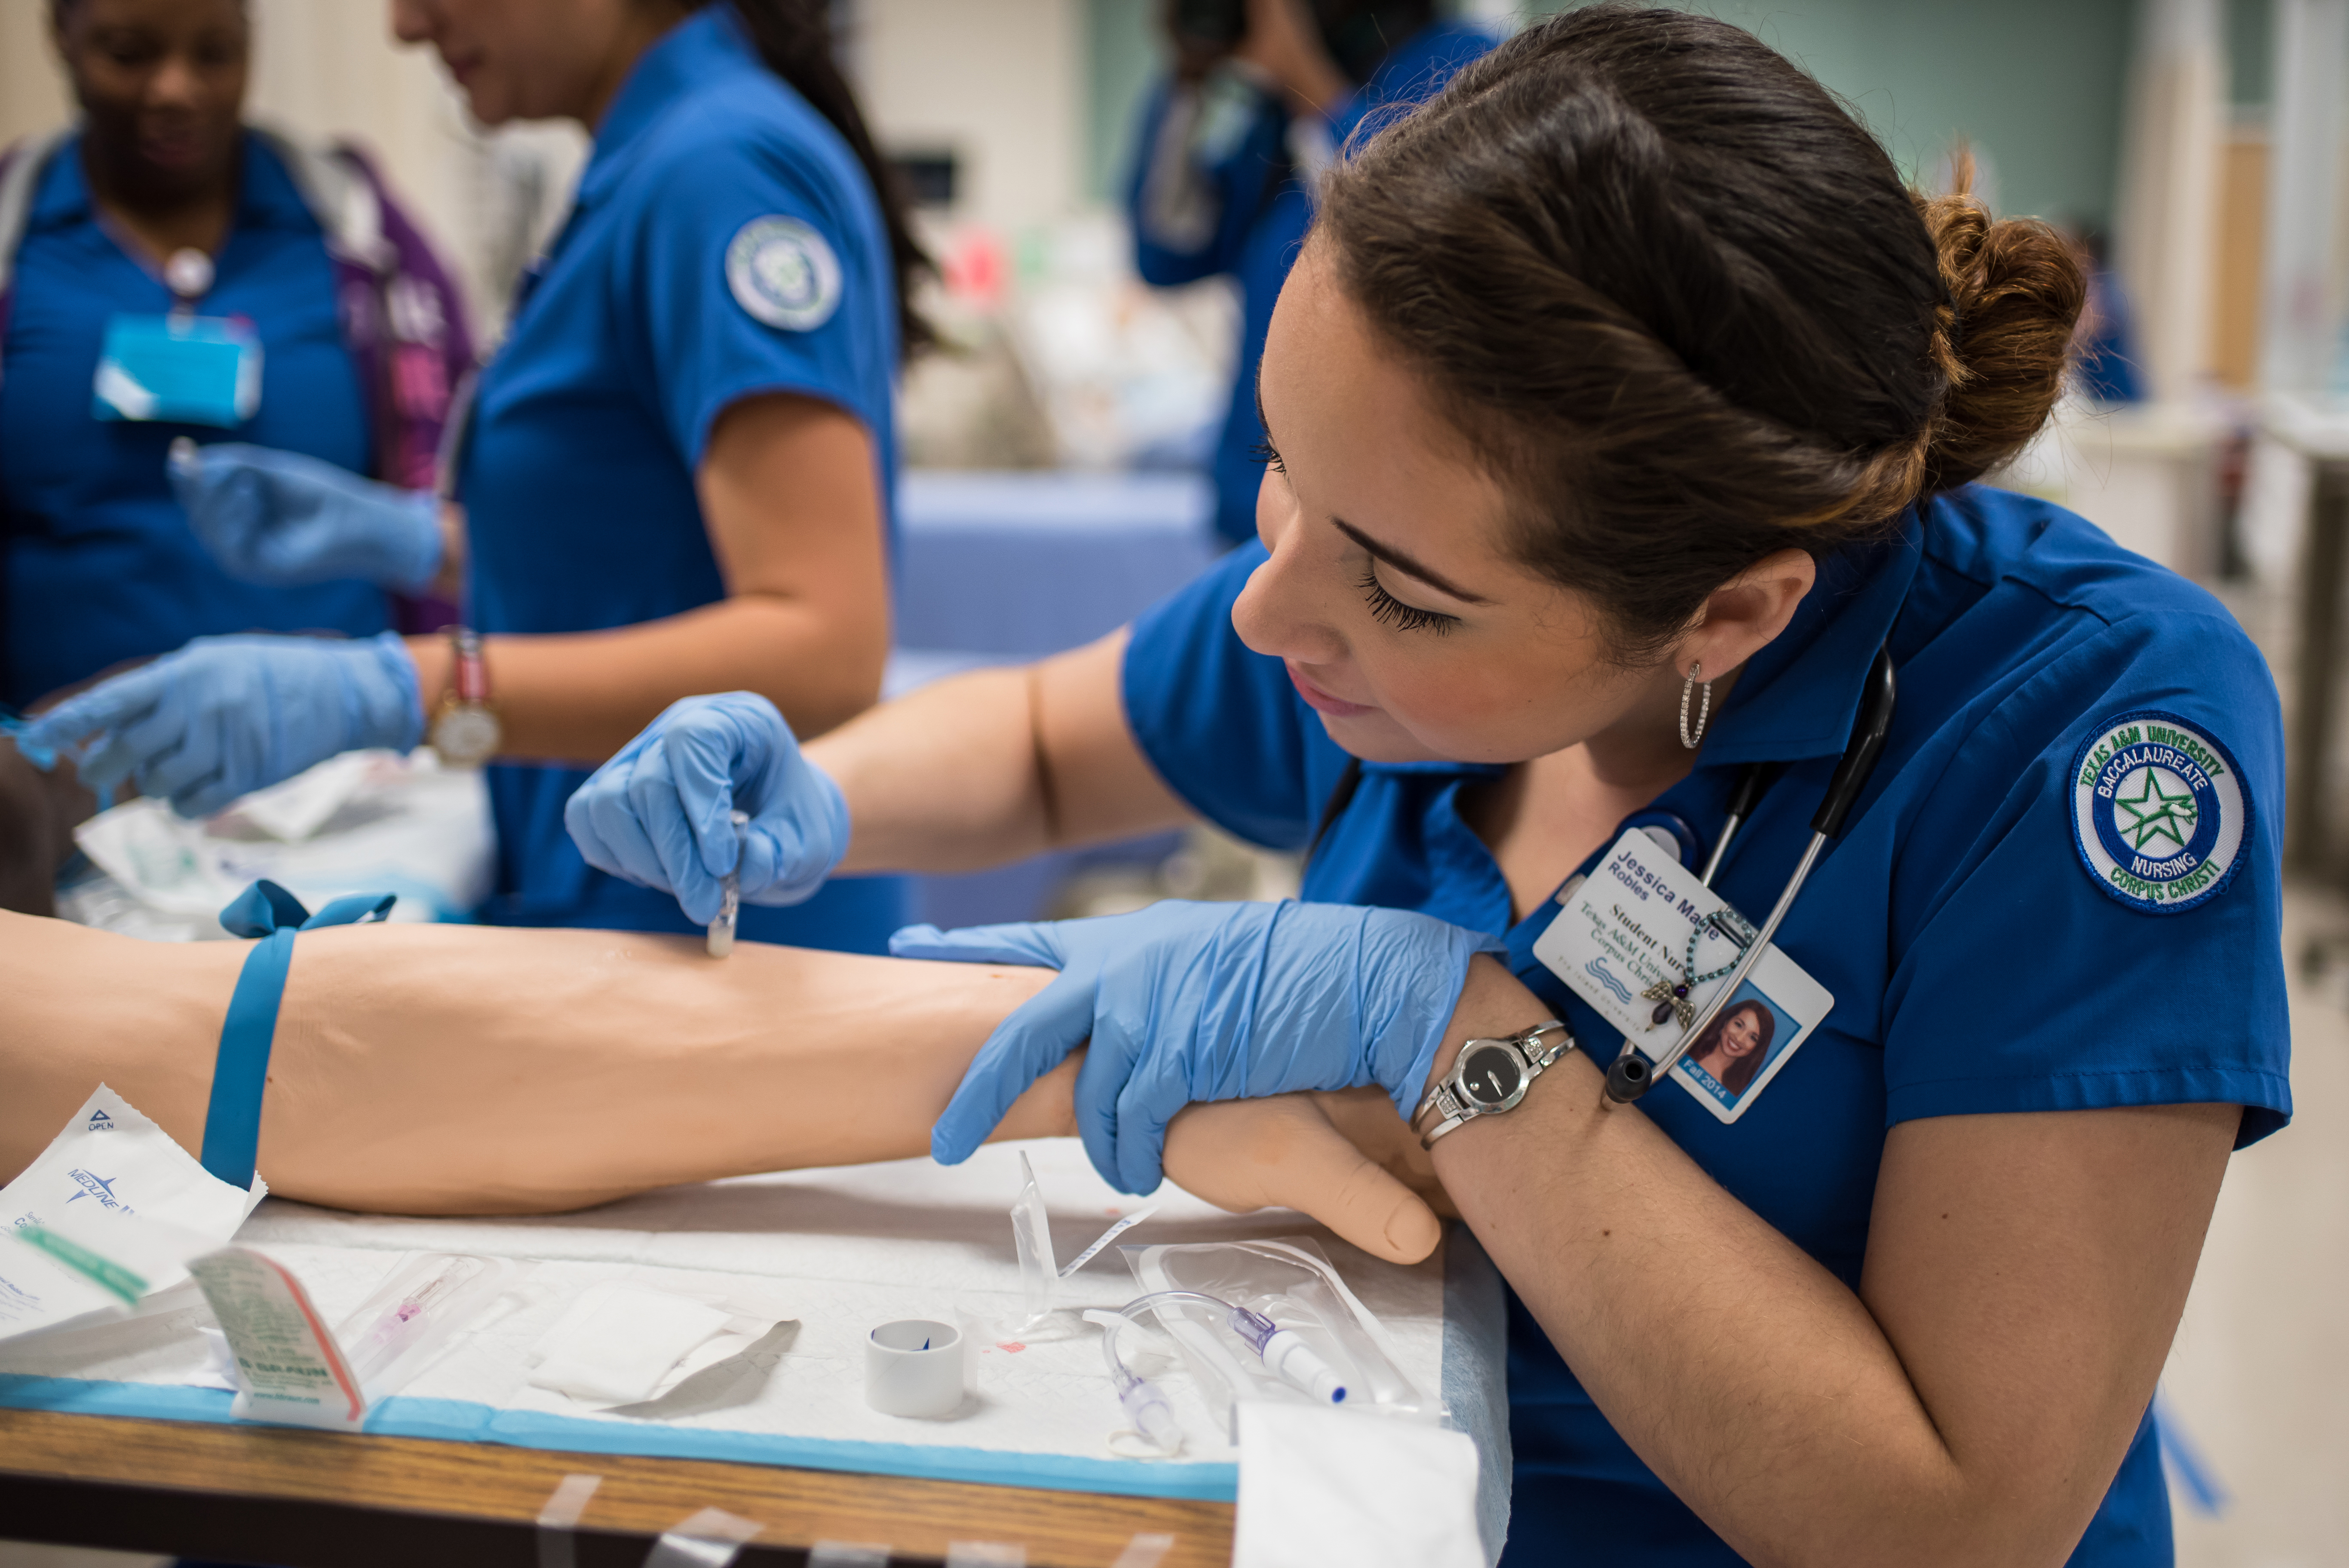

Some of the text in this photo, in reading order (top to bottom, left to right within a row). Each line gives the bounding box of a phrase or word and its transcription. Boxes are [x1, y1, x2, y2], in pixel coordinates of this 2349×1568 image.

[2080, 725, 2224, 787] TEXAS A&M UNIVERSITY
[2097, 747, 2208, 799] BACCALAUREATE
[1608, 861, 1650, 901] Robles
[2110, 859, 2221, 900] CORPUS CHRISTI
[2131, 852, 2198, 878] NURSING
[1618, 851, 1720, 940] Jessica Maie
[1590, 927, 1625, 962] Corpus
[1608, 929, 1639, 956] A&M
[1609, 904, 1658, 949] Student
[1683, 1059, 1726, 1099] Fall 2014
[88, 1122, 114, 1131] OPEN
[67, 1169, 120, 1210] MEDLINE
